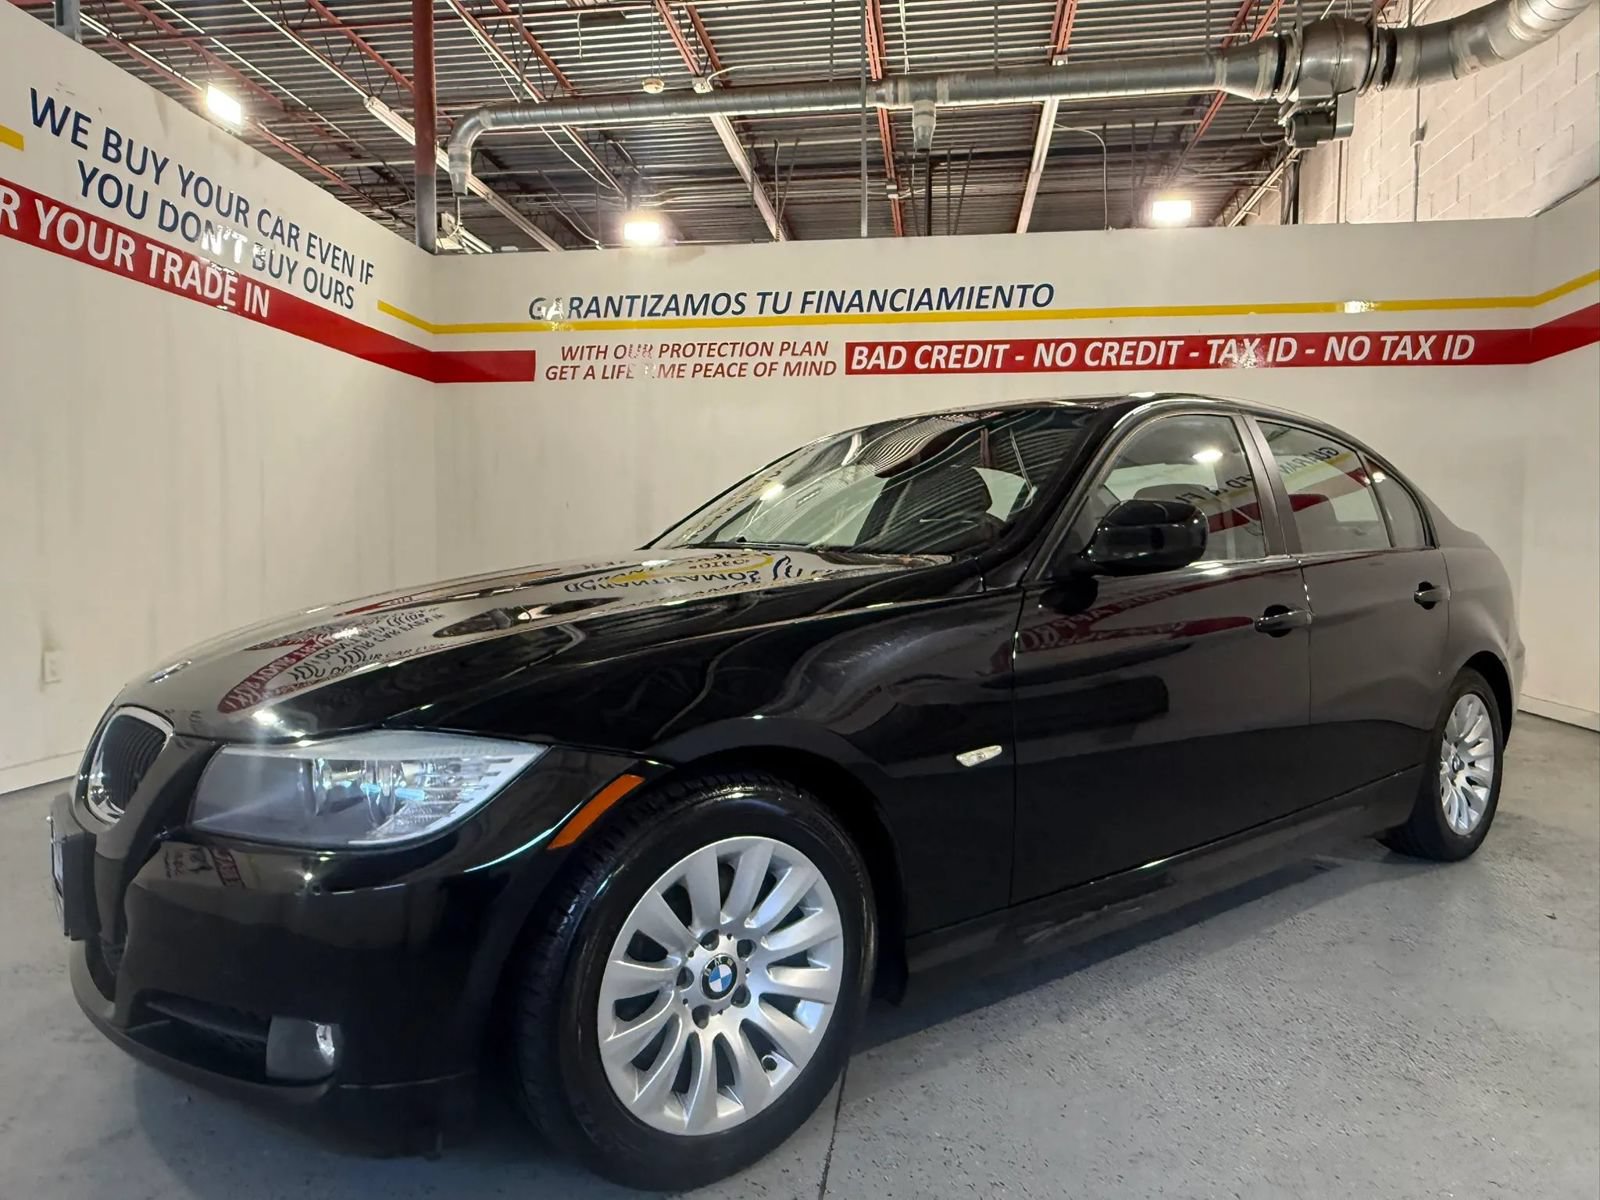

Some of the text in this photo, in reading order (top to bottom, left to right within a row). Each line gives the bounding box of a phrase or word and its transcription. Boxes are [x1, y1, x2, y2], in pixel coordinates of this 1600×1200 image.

[30, 87, 375, 286] WE BUY YOUR CAR EVEN IF
[77, 159, 355, 310] YOU DON'T BUY OURS
[34, 198, 136, 272] YOUR
[145, 242, 239, 308] TRADE
[243, 281, 271, 319] IN
[529, 283, 1055, 321] GARANTIZAMOS TU FINANCIAMIENTO
[560, 341, 829, 361] WITH OUR PROTECTION PLAN
[851, 345, 907, 371] BAD
[914, 343, 1010, 370] CREDIT
[1033, 342, 1077, 368] NO
[1084, 340, 1185, 367] CREDIT
[1206, 338, 1261, 366] TAX
[1267, 337, 1298, 363] ID
[1324, 336, 1371, 362] NO
[1380, 335, 1434, 361] TAX
[1442, 334, 1476, 361] ID
[545, 365, 581, 381] GET
[583, 364, 596, 381] A
[691, 362, 748, 378] PEACE
[753, 361, 779, 377] OF
[782, 360, 838, 377] MIND
